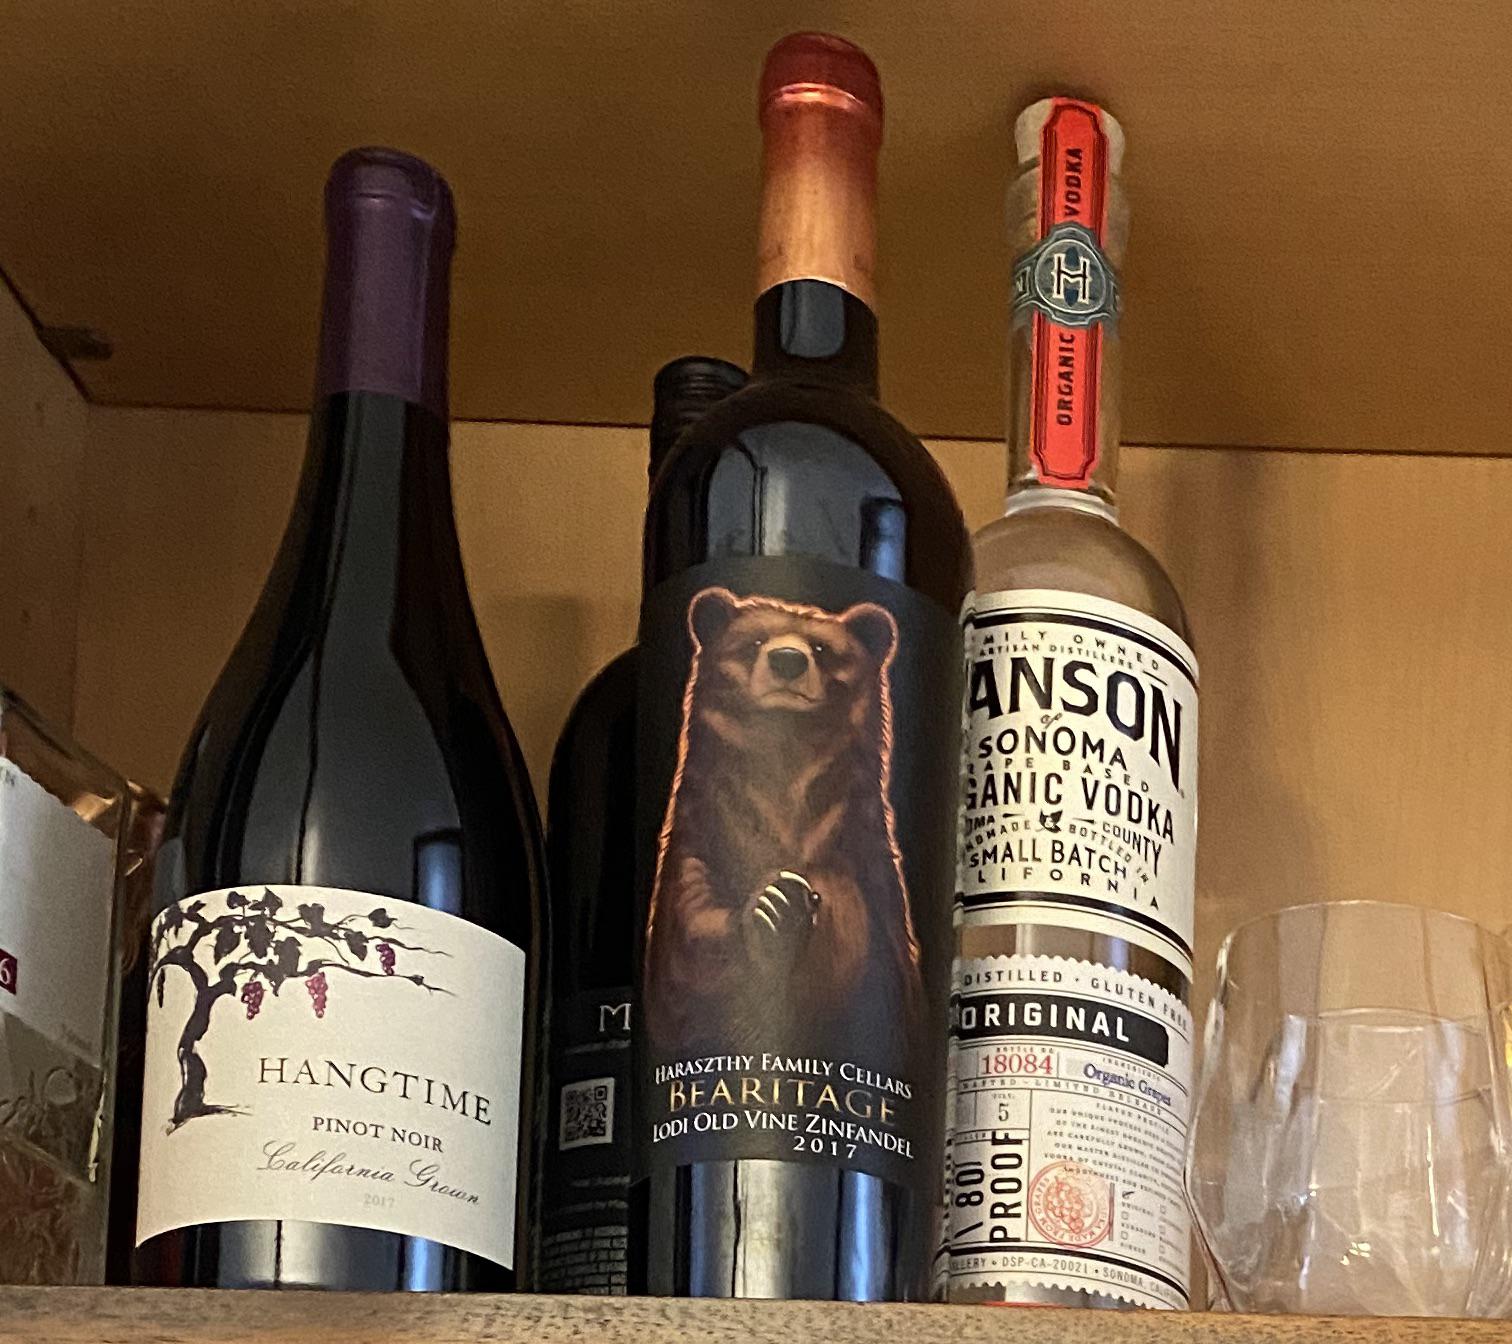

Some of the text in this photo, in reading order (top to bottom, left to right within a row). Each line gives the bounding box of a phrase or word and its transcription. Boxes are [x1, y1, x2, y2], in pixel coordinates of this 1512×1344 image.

[1064, 147, 1084, 216] VODKA
[1057, 333, 1075, 426] ORGANIC
[968, 656, 1184, 793] ANSON
[978, 725, 1128, 771] SONOMA
[1081, 776, 1175, 846] VODKA
[969, 838, 1127, 879] SMALL BATCH
[964, 970, 1157, 1010] DISTILLED GLUTEN
[962, 1002, 1129, 1043] ORIGINAL
[655, 1053, 912, 1099] HARASZTHY FAMILY CELLARS
[981, 1054, 1053, 1076] 18084
[258, 1056, 492, 1127] HANGTIME
[669, 1077, 897, 1127] BEARITAGE
[312, 1115, 443, 1153] PINOT NOIR
[653, 1110, 914, 1159] LODI OLD VINE ZINFANDEL
[793, 1135, 857, 1159] 2017
[257, 1141, 480, 1206] California Grown
[990, 1130, 1024, 1243] PROOF
